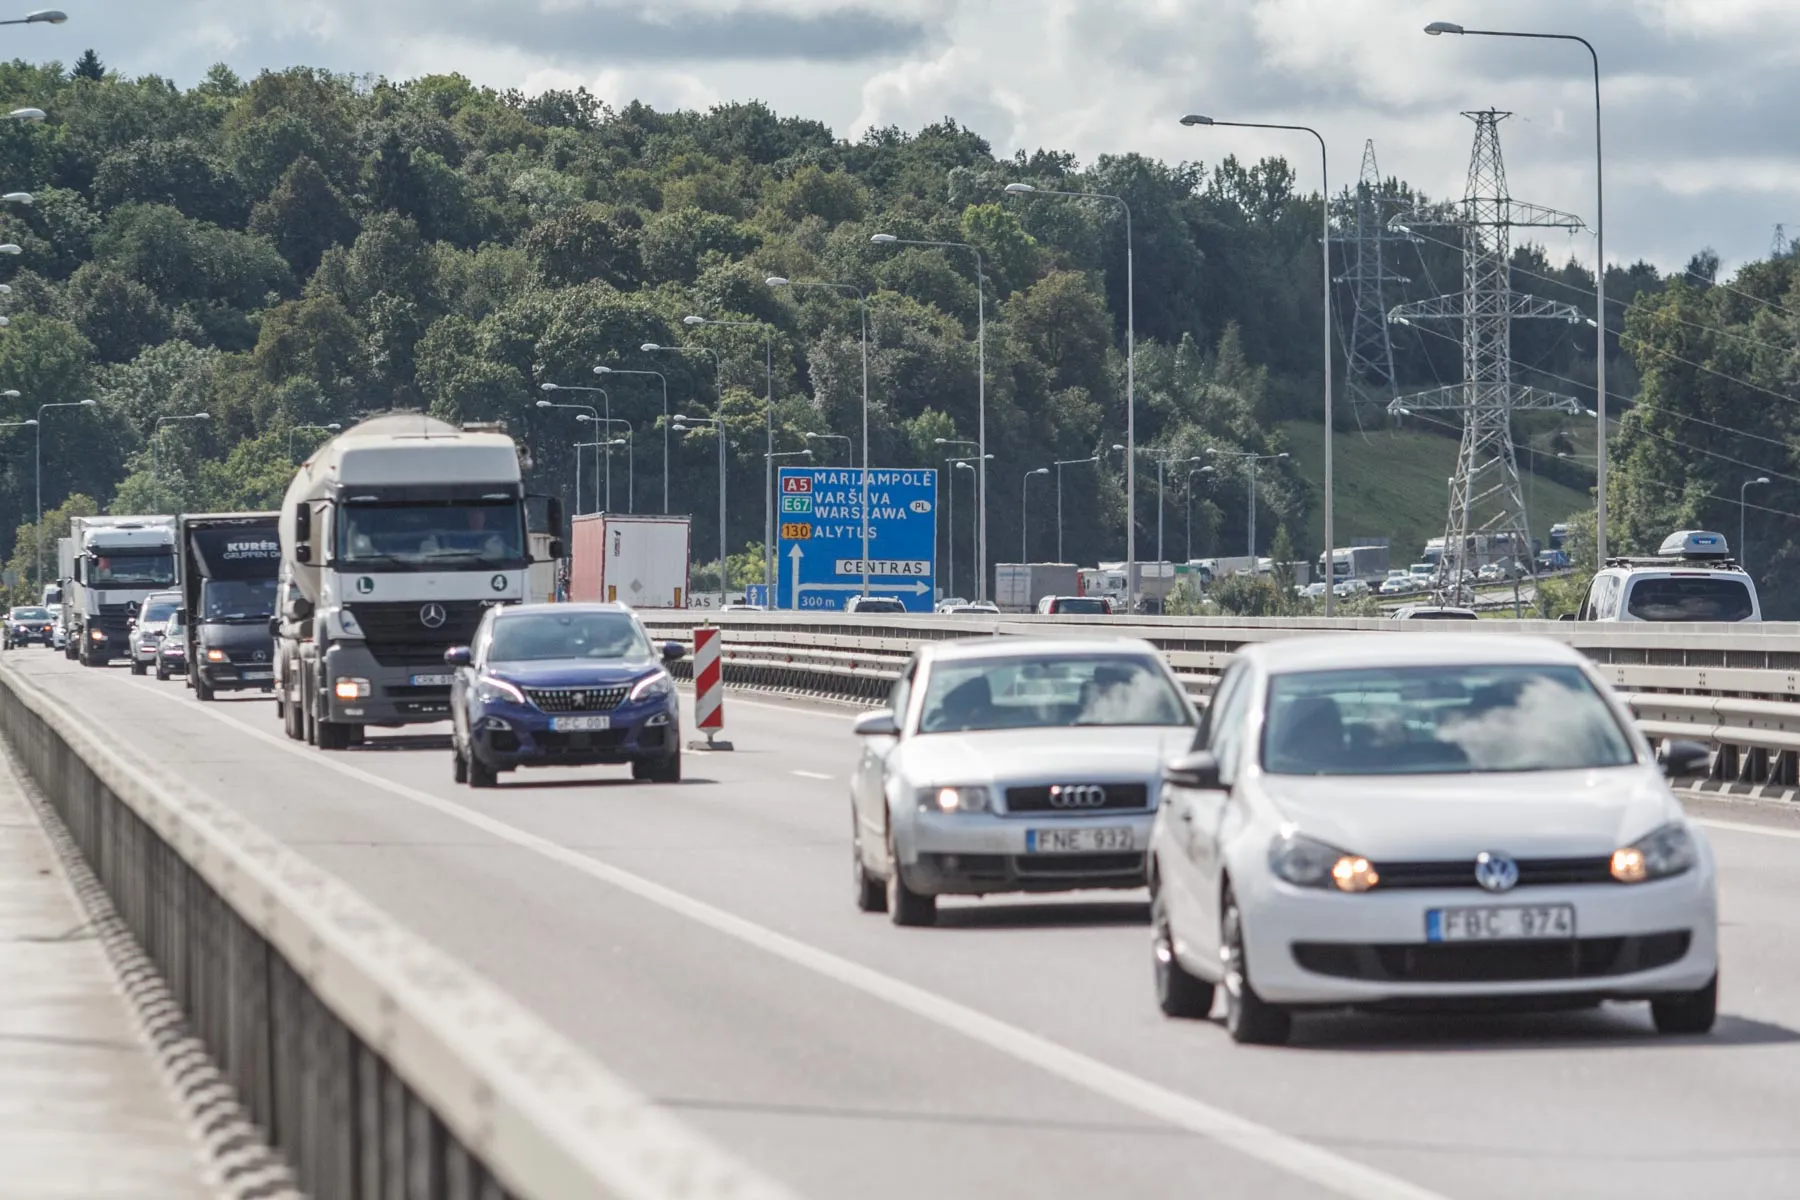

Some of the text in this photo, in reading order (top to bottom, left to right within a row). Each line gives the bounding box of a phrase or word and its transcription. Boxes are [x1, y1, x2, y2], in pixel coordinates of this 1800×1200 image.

[787, 479, 808, 491] A5
[814, 471, 932, 487] MARIJAMPOLĖ
[815, 488, 891, 505] VARŠUVA
[784, 499, 810, 511] E67
[914, 502, 928, 511] PL
[785, 525, 808, 538] 130
[814, 525, 878, 539] ALYTUS
[843, 560, 922, 574] CENTRAS
[802, 596, 835, 607] 300 m
[1039, 828, 1128, 850] FNE 932
[1520, 903, 1568, 935] 974
